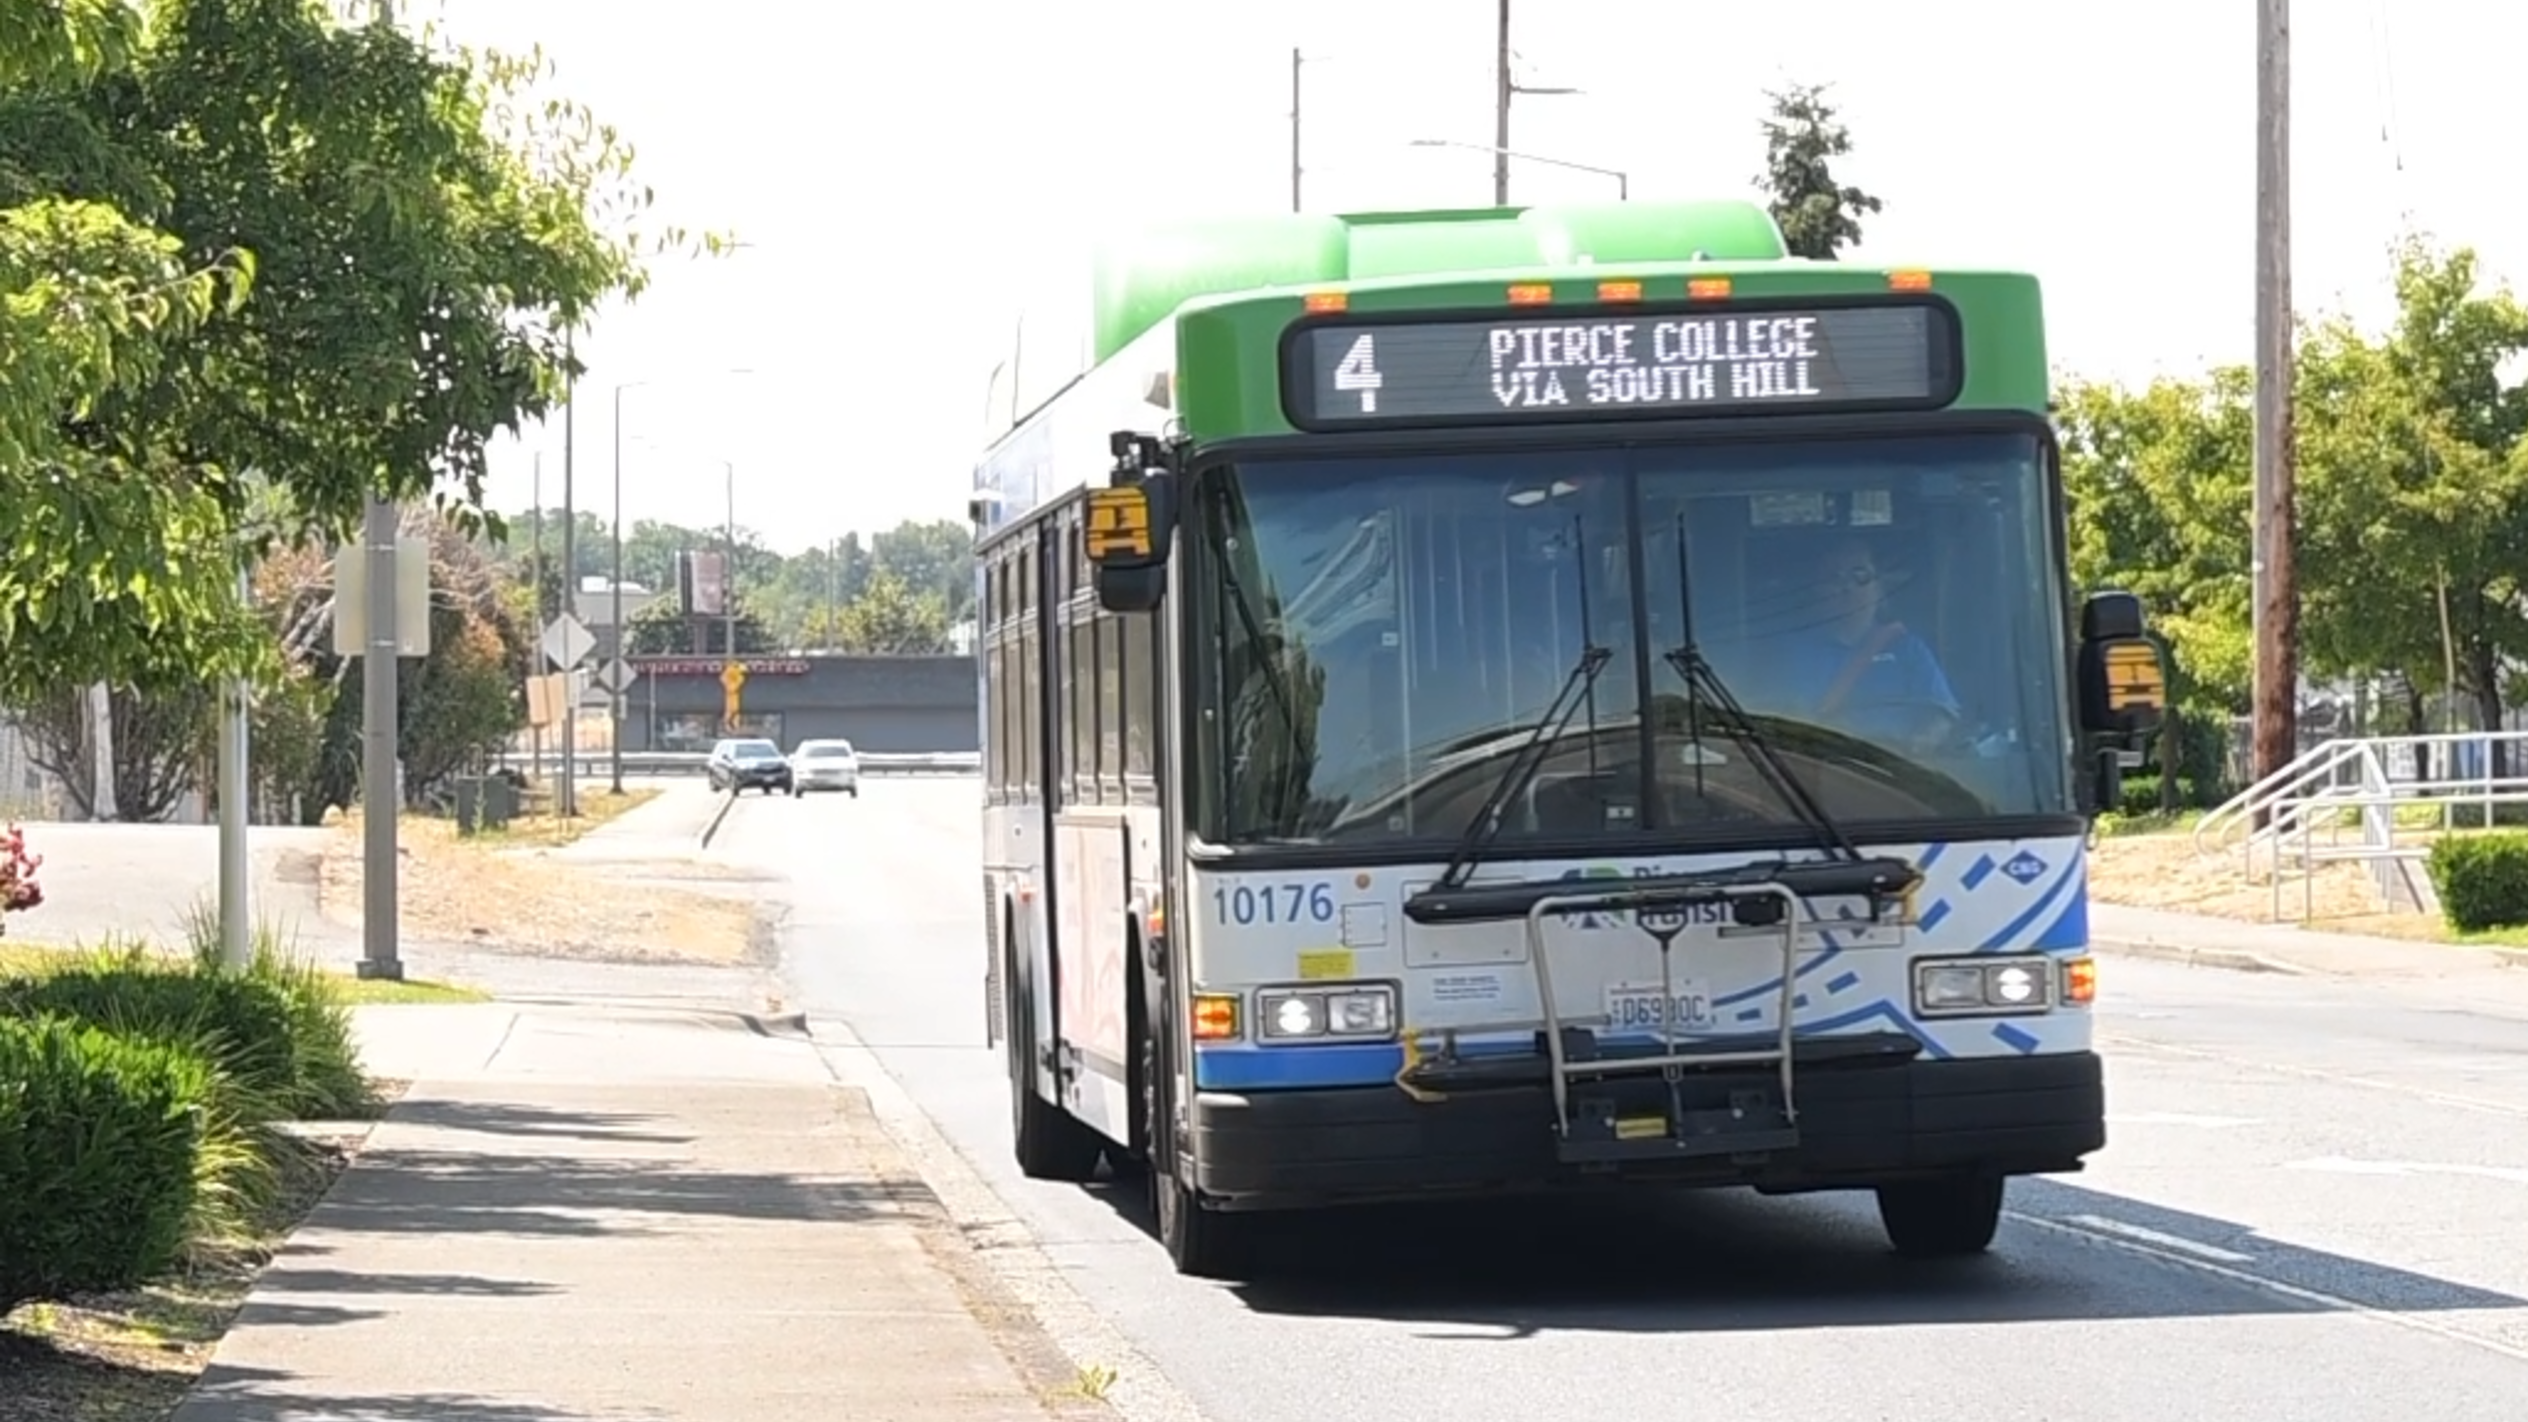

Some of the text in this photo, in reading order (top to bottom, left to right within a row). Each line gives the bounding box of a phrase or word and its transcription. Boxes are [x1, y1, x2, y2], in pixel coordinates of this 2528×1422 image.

[1490, 317, 1819, 369] PIERCE COLLEGE
[1334, 333, 1383, 412] 4
[1491, 359, 1821, 407] VIA SOUTH HILL
[1213, 882, 1335, 926] 10176
